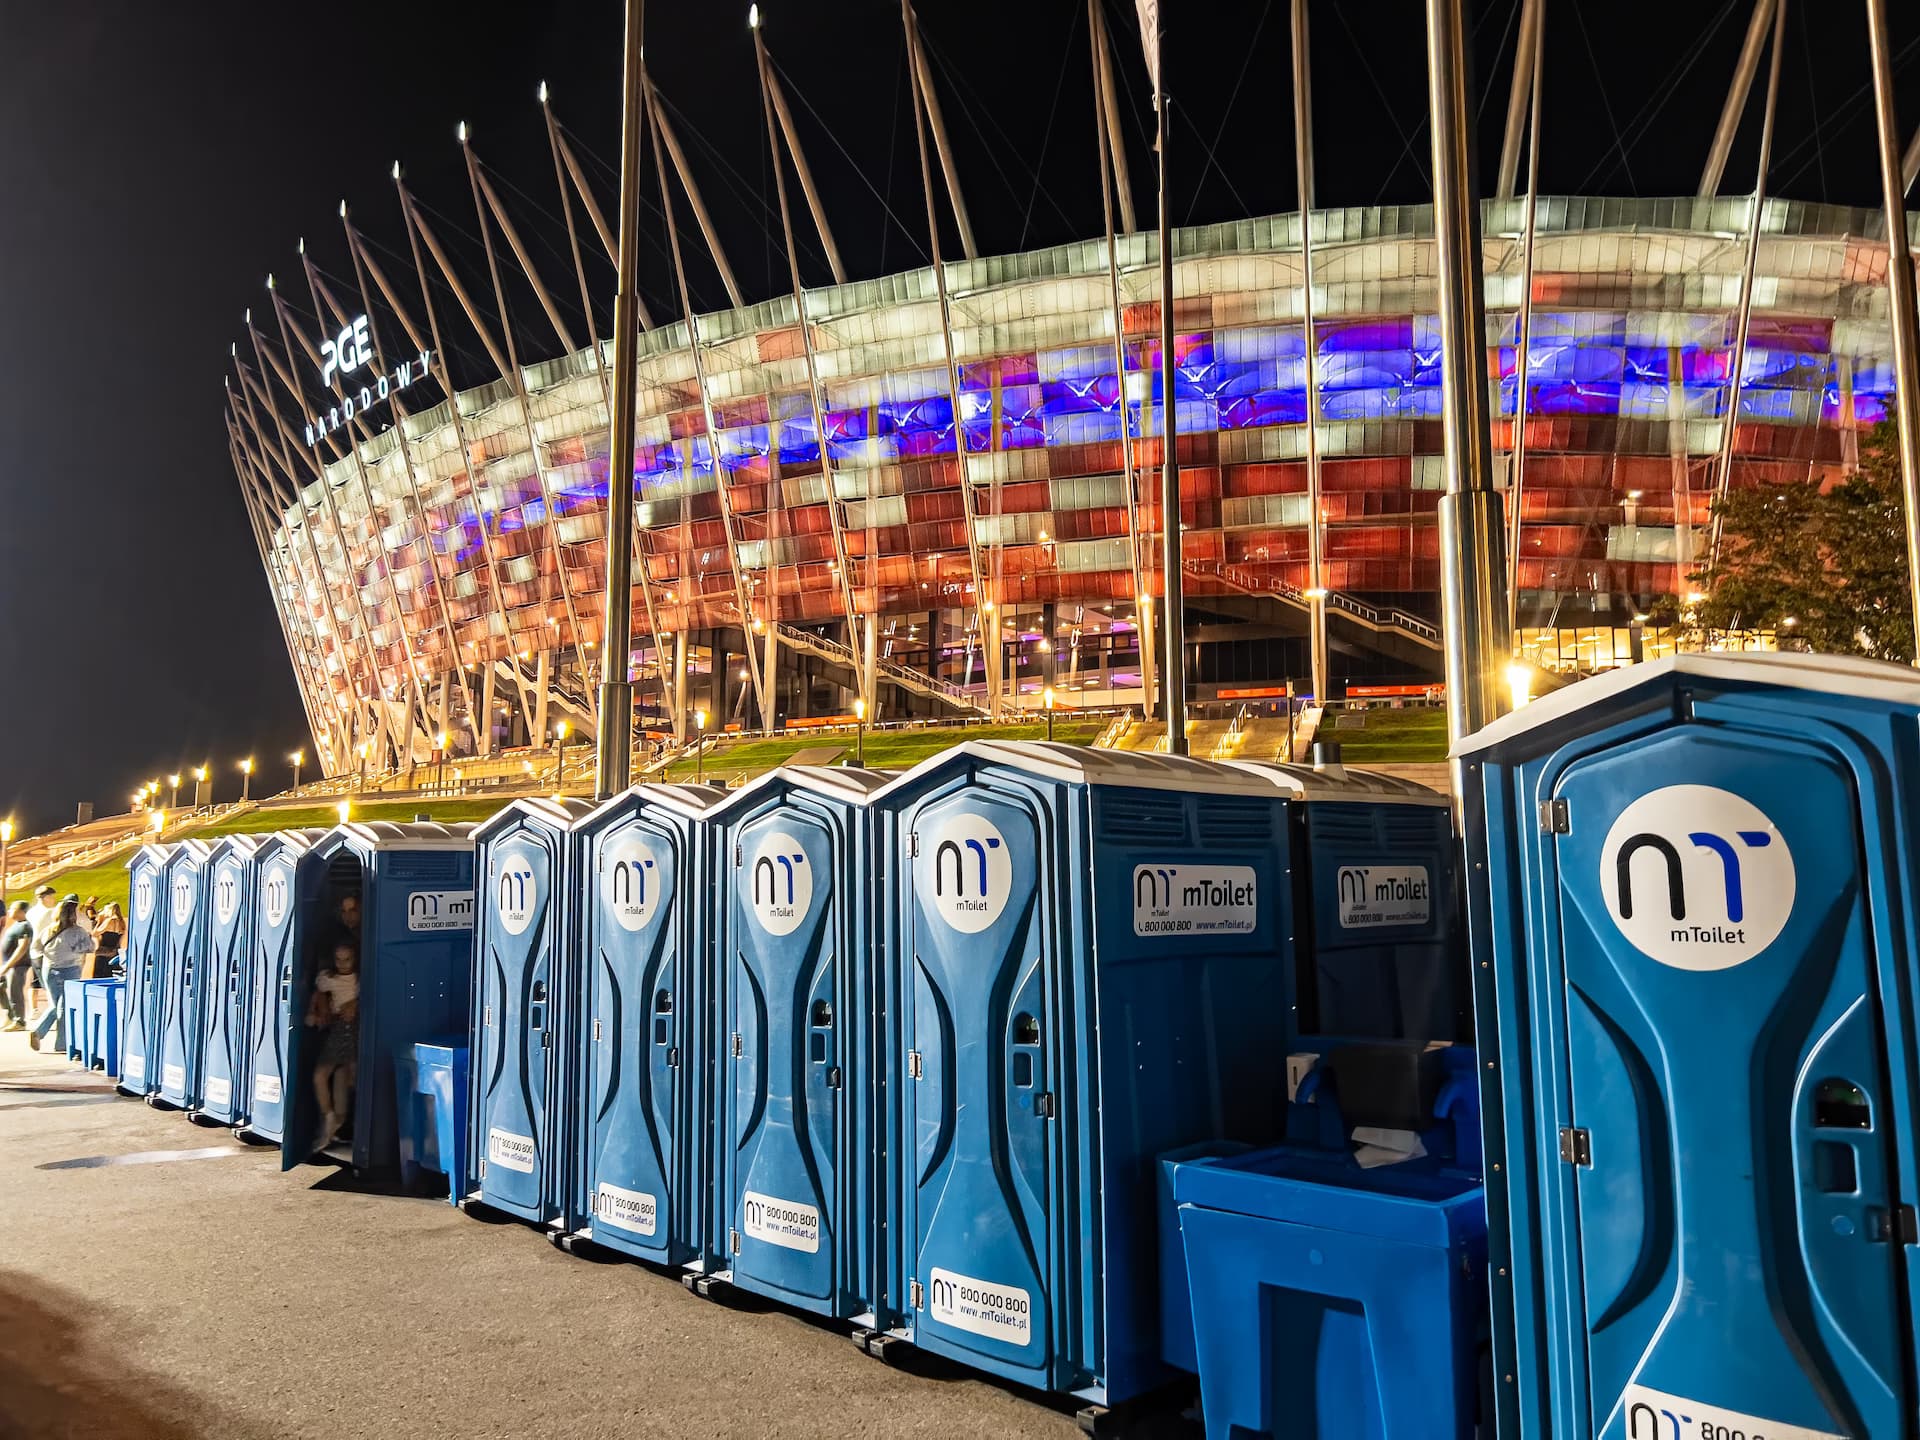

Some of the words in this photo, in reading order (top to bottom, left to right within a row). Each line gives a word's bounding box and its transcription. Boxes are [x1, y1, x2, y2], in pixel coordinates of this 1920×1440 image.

[320, 314, 372, 387] PGE
[305, 350, 430, 447] NARODOWY
[1183, 880, 1254, 906] mToilet
[1375, 877, 1427, 901] mToilet
[625, 906, 645, 915] mToilet
[770, 907, 794, 917] mToilet
[956, 899, 988, 911] mToilet
[1144, 921, 1160, 932] 800
[1160, 920, 1176, 931] 000
[1176, 920, 1192, 931] 800
[1196, 919, 1253, 931] www.mToilet.pl
[1671, 926, 1746, 944] mToilet
[616, 1197, 626, 1209] 800
[627, 1200, 640, 1212] 000
[641, 1203, 655, 1215] 800
[766, 1206, 781, 1220] 800
[782, 1210, 798, 1224] 000
[800, 1213, 817, 1228] 800
[960, 1286, 980, 1303] 800
[981, 1292, 1003, 1309] 000
[1005, 1297, 1028, 1314] 800
